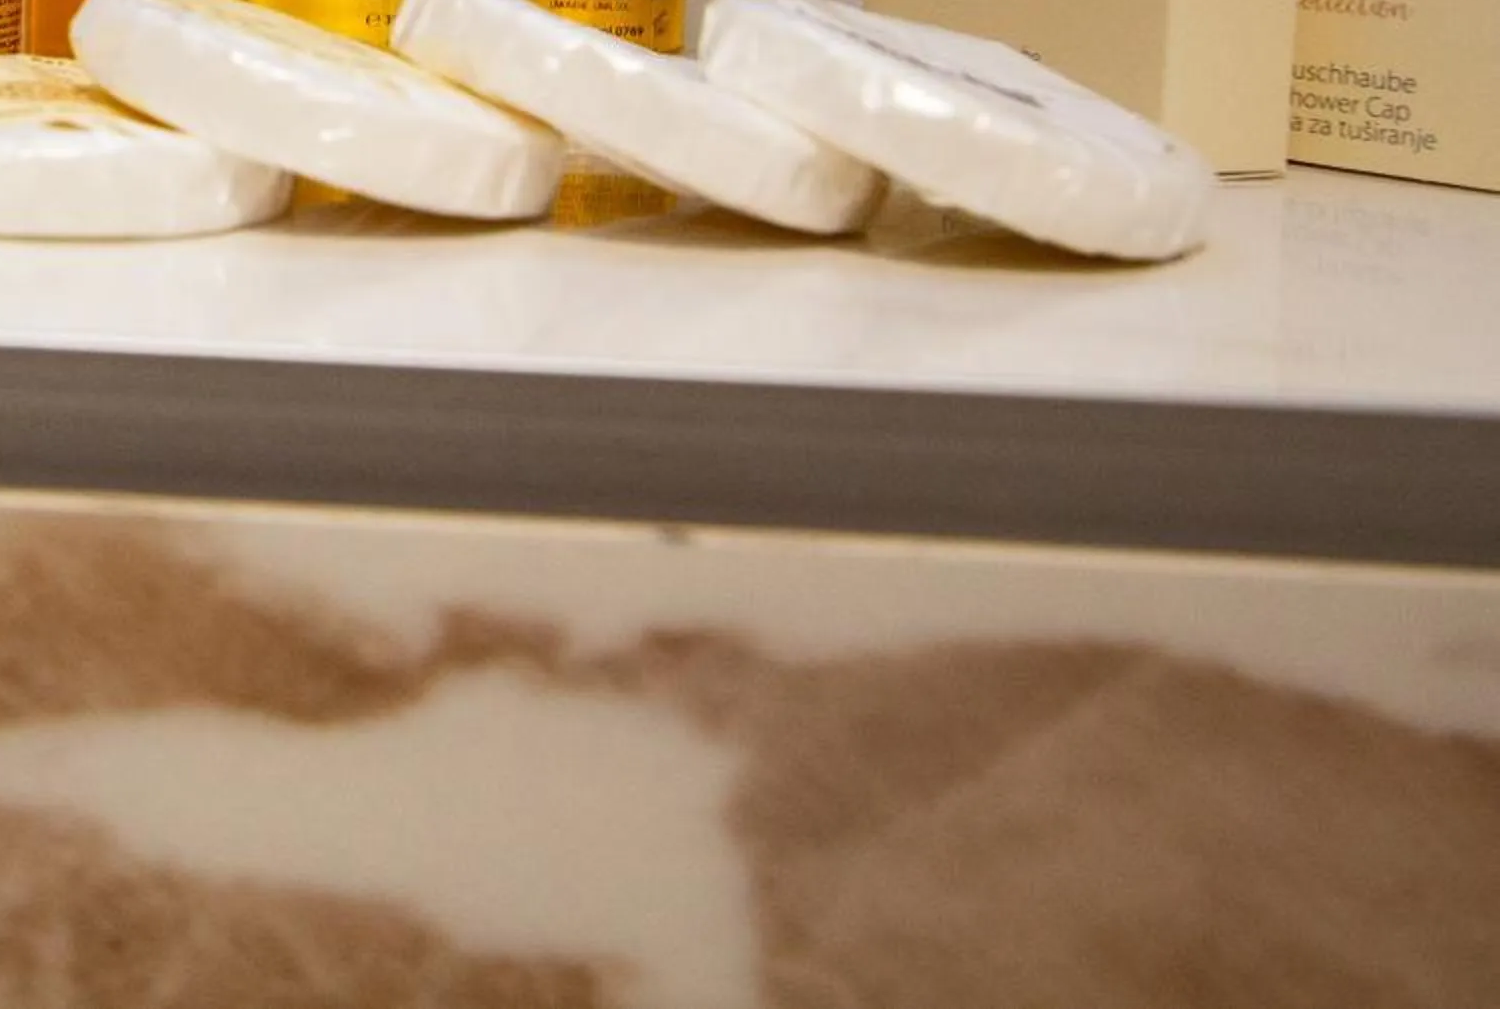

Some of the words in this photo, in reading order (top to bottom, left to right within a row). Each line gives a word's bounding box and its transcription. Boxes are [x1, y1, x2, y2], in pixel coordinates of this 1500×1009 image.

[1291, 62, 1417, 94] uschhaube
[1290, 87, 1359, 114] hower
[1365, 96, 1411, 124] Cap
[1308, 118, 1332, 136] za
[1339, 120, 1438, 154] tuširanje
